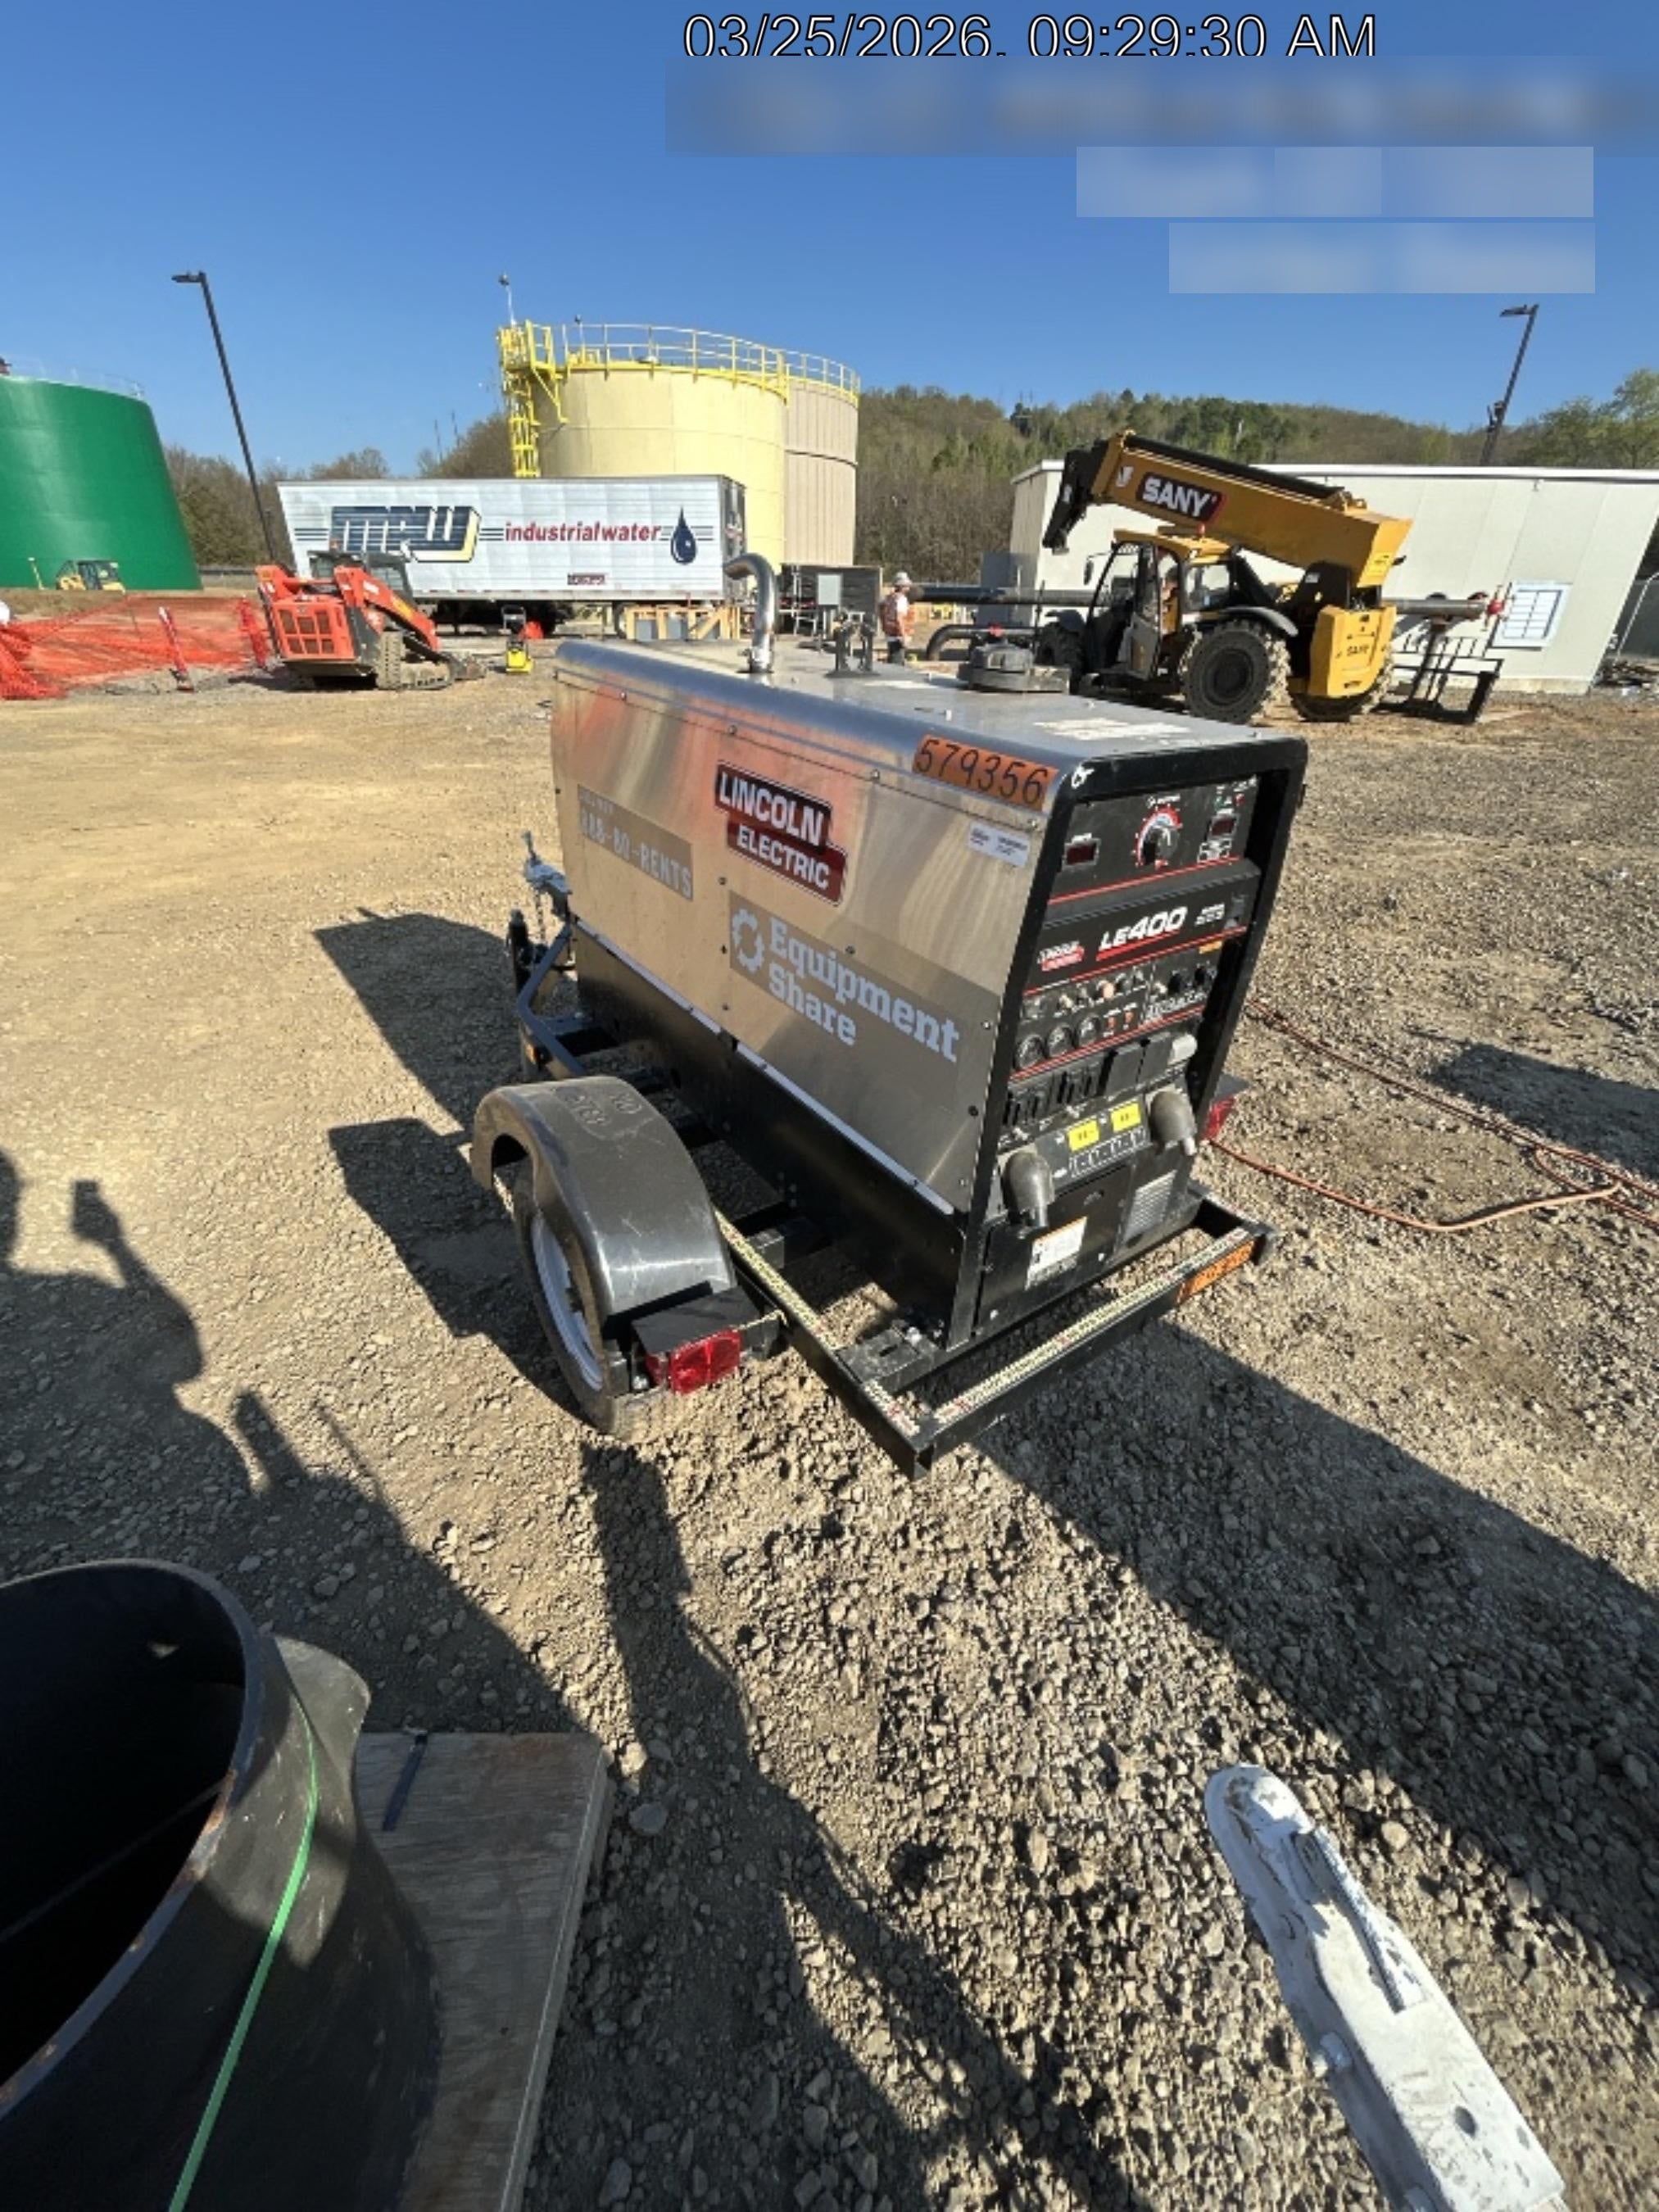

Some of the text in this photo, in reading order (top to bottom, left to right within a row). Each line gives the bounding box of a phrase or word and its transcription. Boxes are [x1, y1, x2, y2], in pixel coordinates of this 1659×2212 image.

[1142, 478, 1211, 517] SANY
[916, 739, 1049, 805] 579356
[719, 772, 824, 846] LINCOLN
[738, 824, 830, 890] ELECTRIC
[1098, 906, 1189, 952] LE400
[768, 917, 959, 1063] Equipment
[768, 962, 856, 1046] Share
